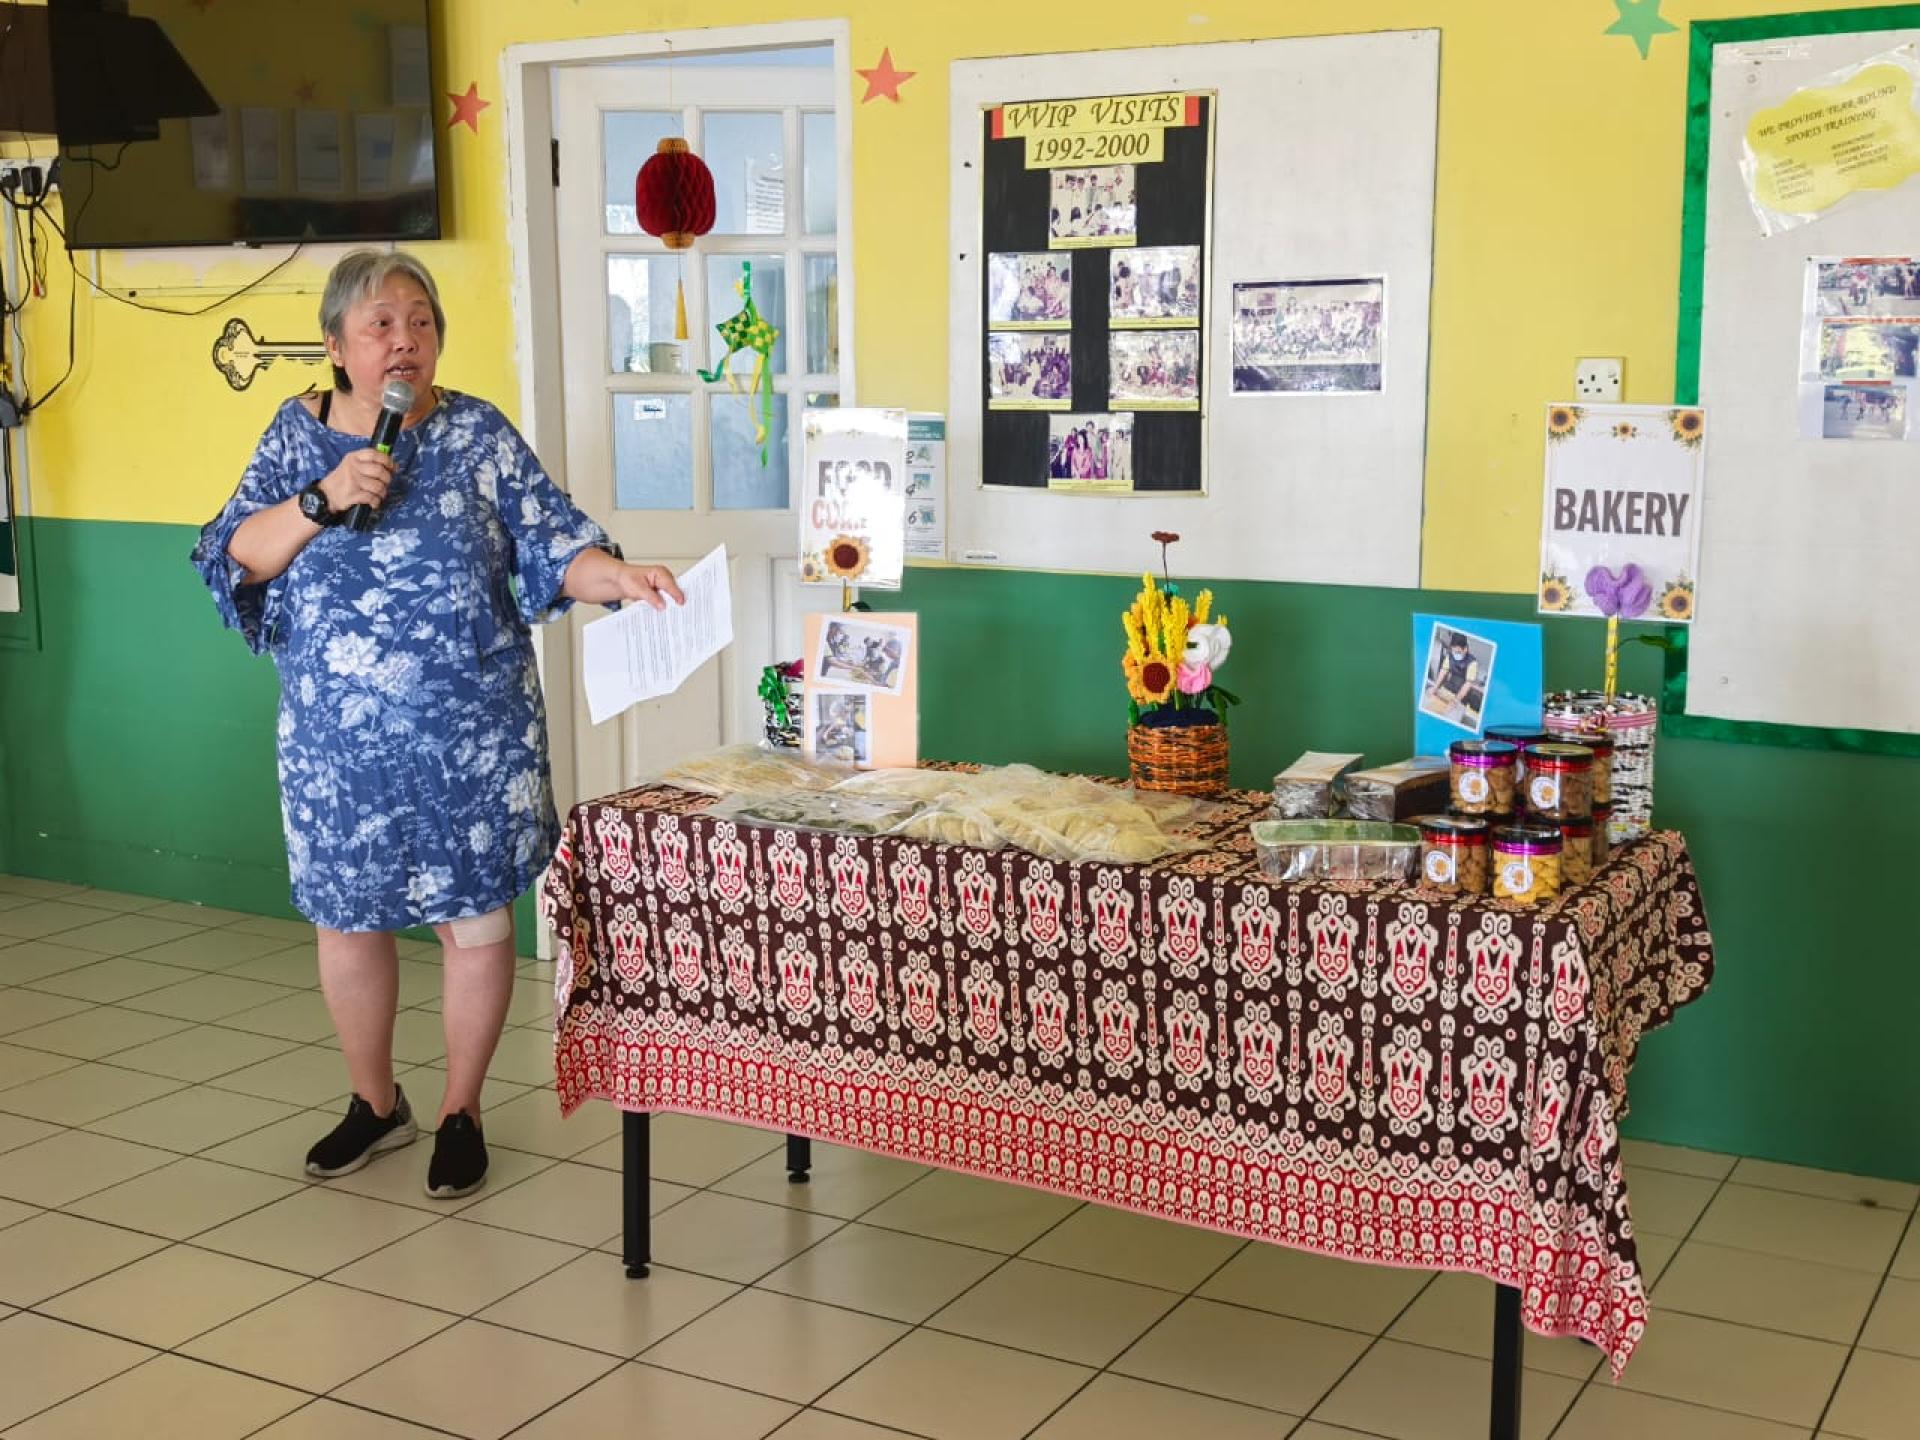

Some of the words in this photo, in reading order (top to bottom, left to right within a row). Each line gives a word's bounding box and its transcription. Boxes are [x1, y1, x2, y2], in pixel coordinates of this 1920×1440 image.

[1008, 99, 1077, 129] VVIP
[1091, 95, 1180, 124] VISITS
[1778, 109, 1824, 131] PROVIDE
[1824, 108, 1877, 131] TRAINING
[1033, 132, 1150, 162] 1992-2000
[1554, 488, 1690, 537] BAKERY
